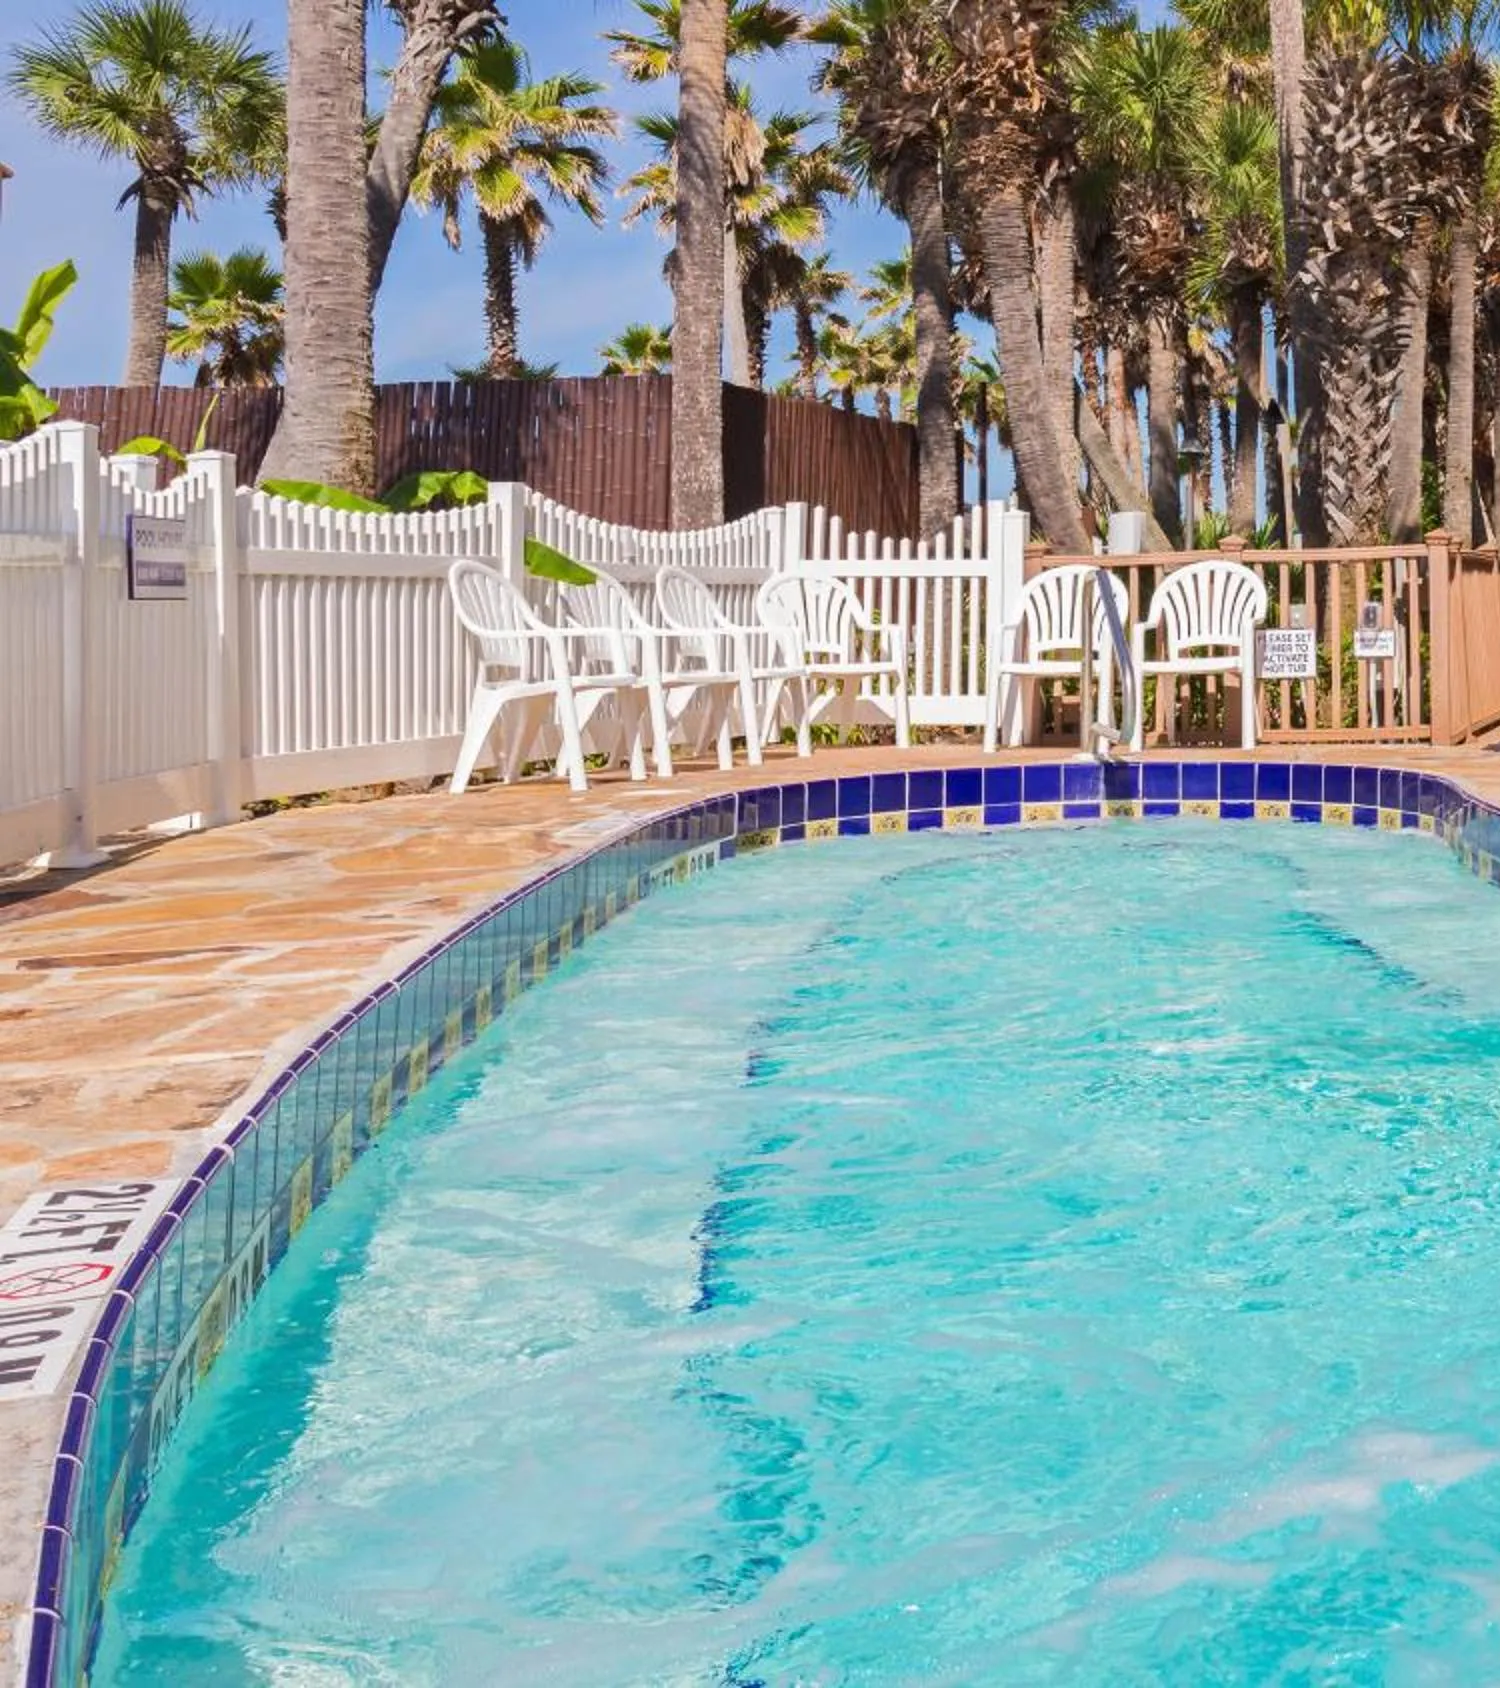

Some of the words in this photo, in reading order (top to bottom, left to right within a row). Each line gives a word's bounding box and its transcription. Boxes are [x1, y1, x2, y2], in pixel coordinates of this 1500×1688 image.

[1295, 633, 1312, 642] SET
[1295, 643, 1309, 652] TO
[1264, 653, 1308, 663] ACTIVATE
[1264, 663, 1286, 673] HOT
[1288, 663, 1307, 673] TUB
